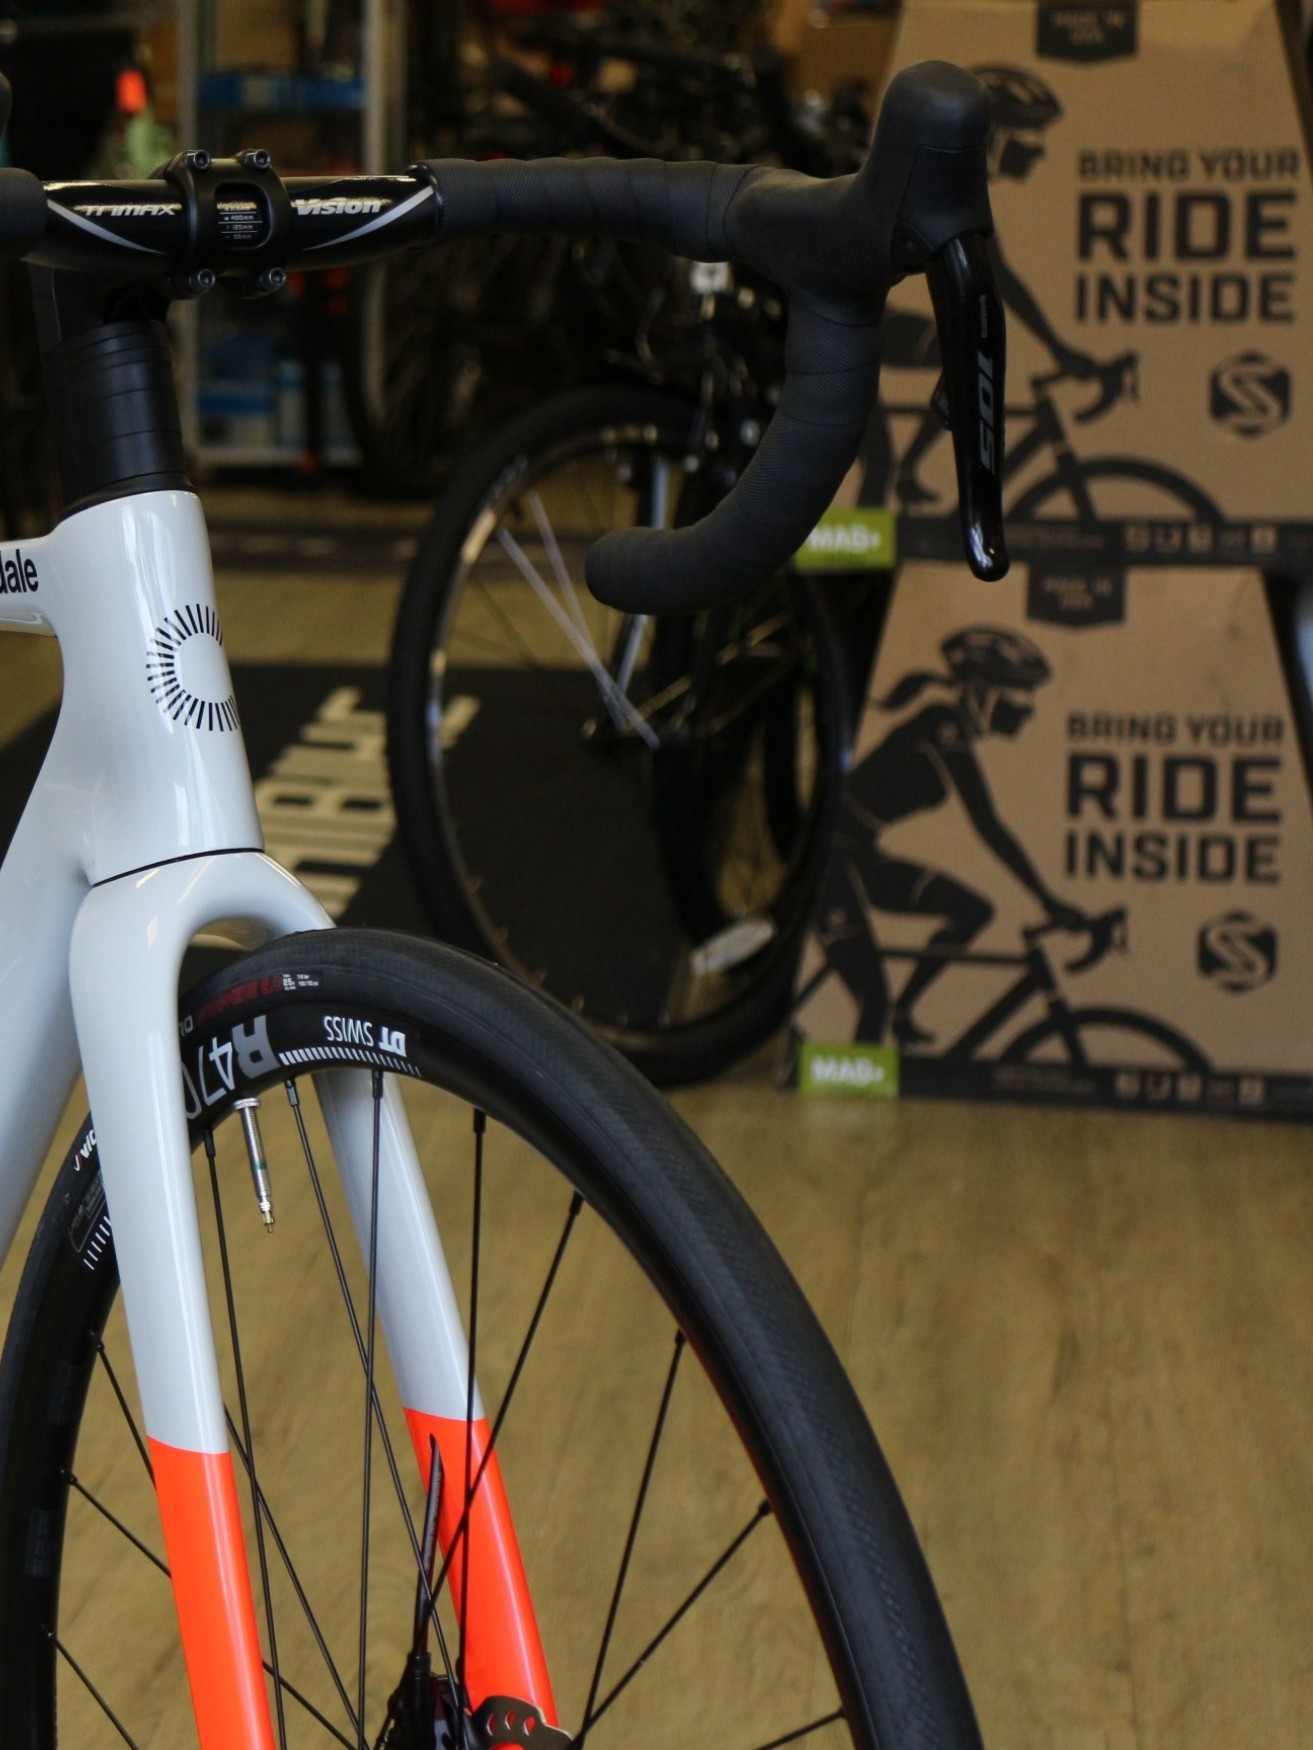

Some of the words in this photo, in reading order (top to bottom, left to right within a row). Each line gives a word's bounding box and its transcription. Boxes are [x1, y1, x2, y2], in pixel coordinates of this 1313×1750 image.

[1079, 150, 1187, 178] BRING
[1200, 149, 1300, 178] YOUR
[295, 197, 381, 216] Vision
[1077, 191, 1297, 260] RIDE
[1077, 273, 1296, 324] INSIDE
[1068, 713, 1176, 743] BRING
[1189, 714, 1283, 743] YOUR
[1067, 753, 1282, 824] RIDE
[1066, 831, 1282, 885] INSIDE
[324, 1015, 374, 1047] SWISS
[378, 1026, 406, 1057] DT
